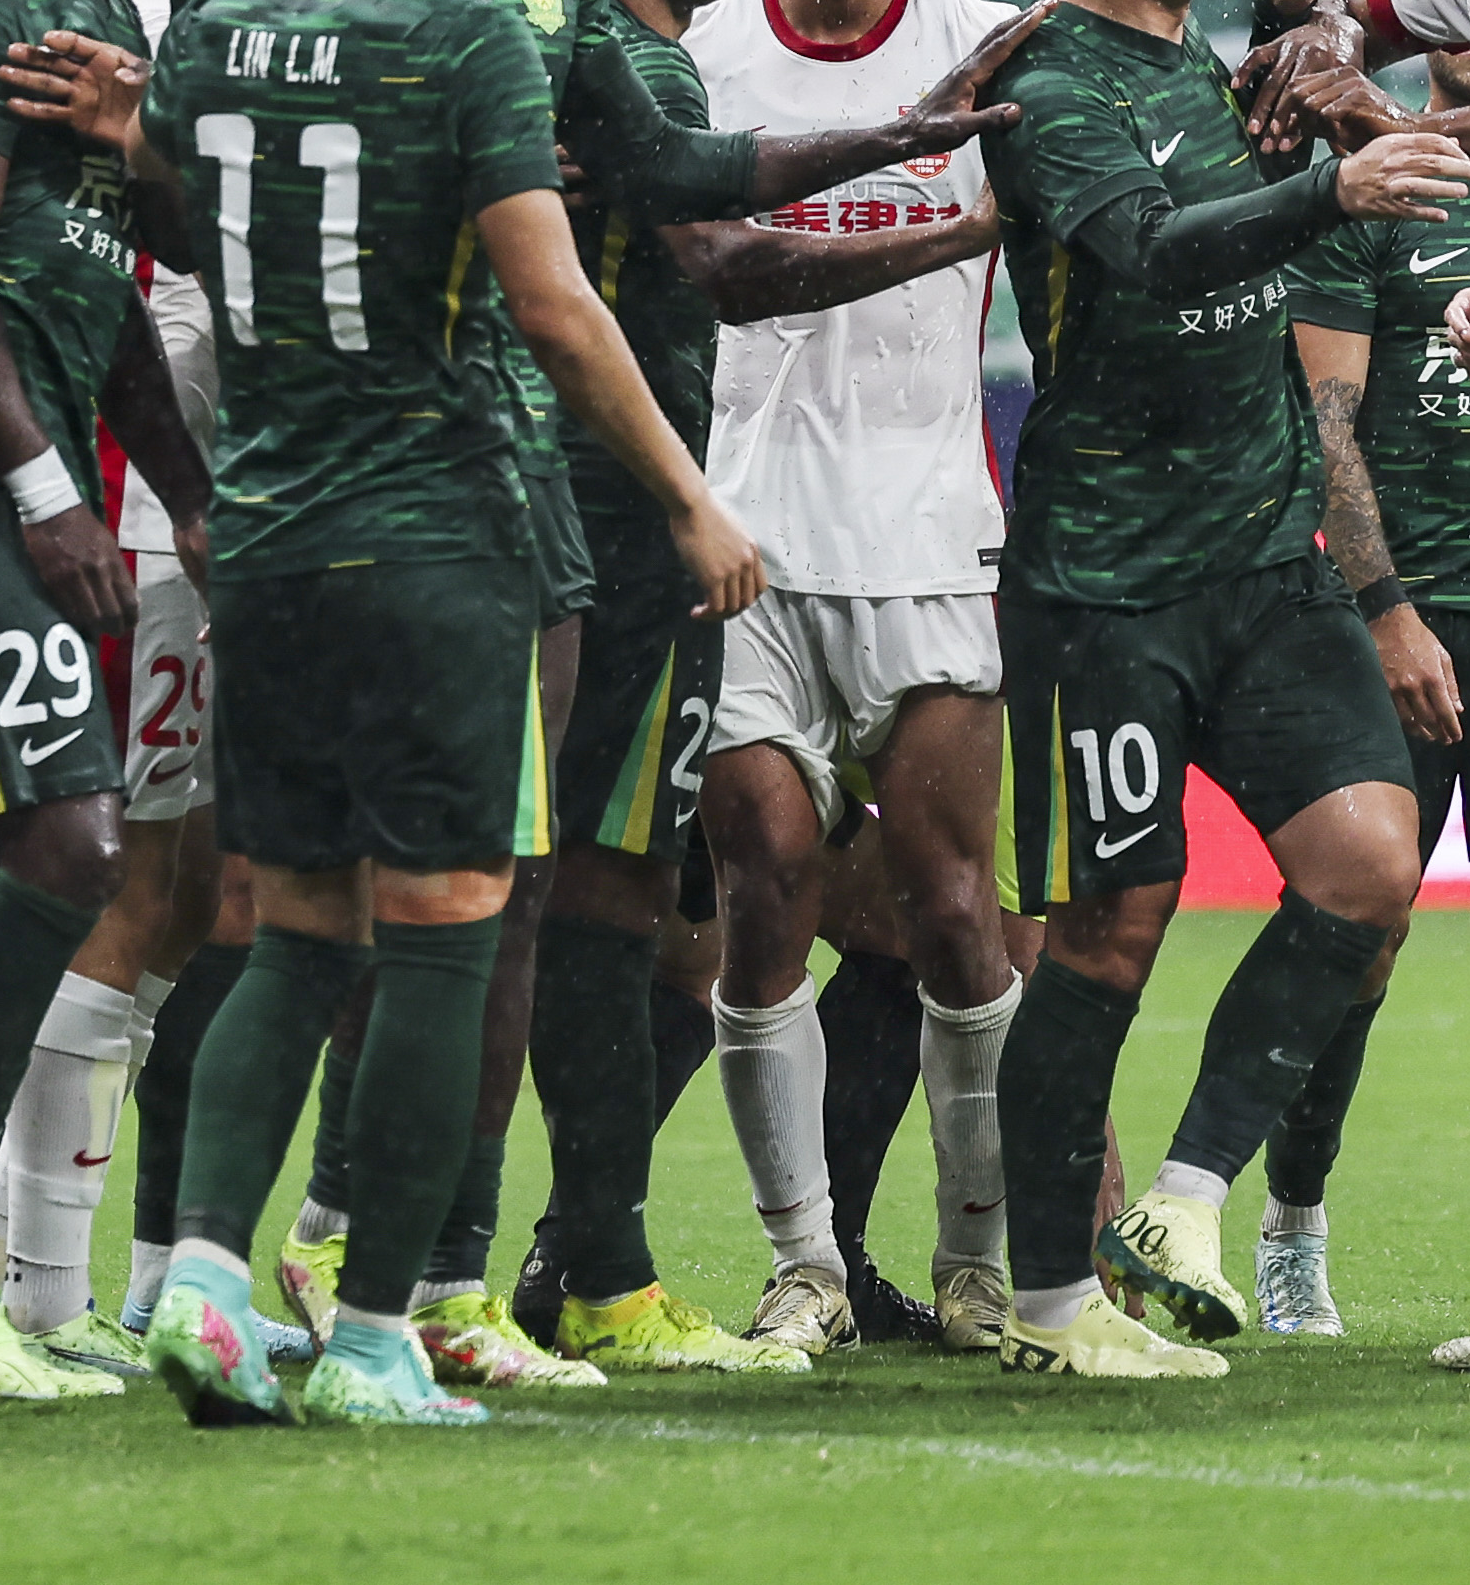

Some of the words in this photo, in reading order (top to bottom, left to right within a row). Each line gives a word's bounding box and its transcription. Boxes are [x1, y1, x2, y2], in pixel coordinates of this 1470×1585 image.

[226, 28, 277, 79] LIN
[286, 34, 342, 86] L.M.
[194, 113, 371, 352] 11
[1070, 721, 1160, 822] 10
